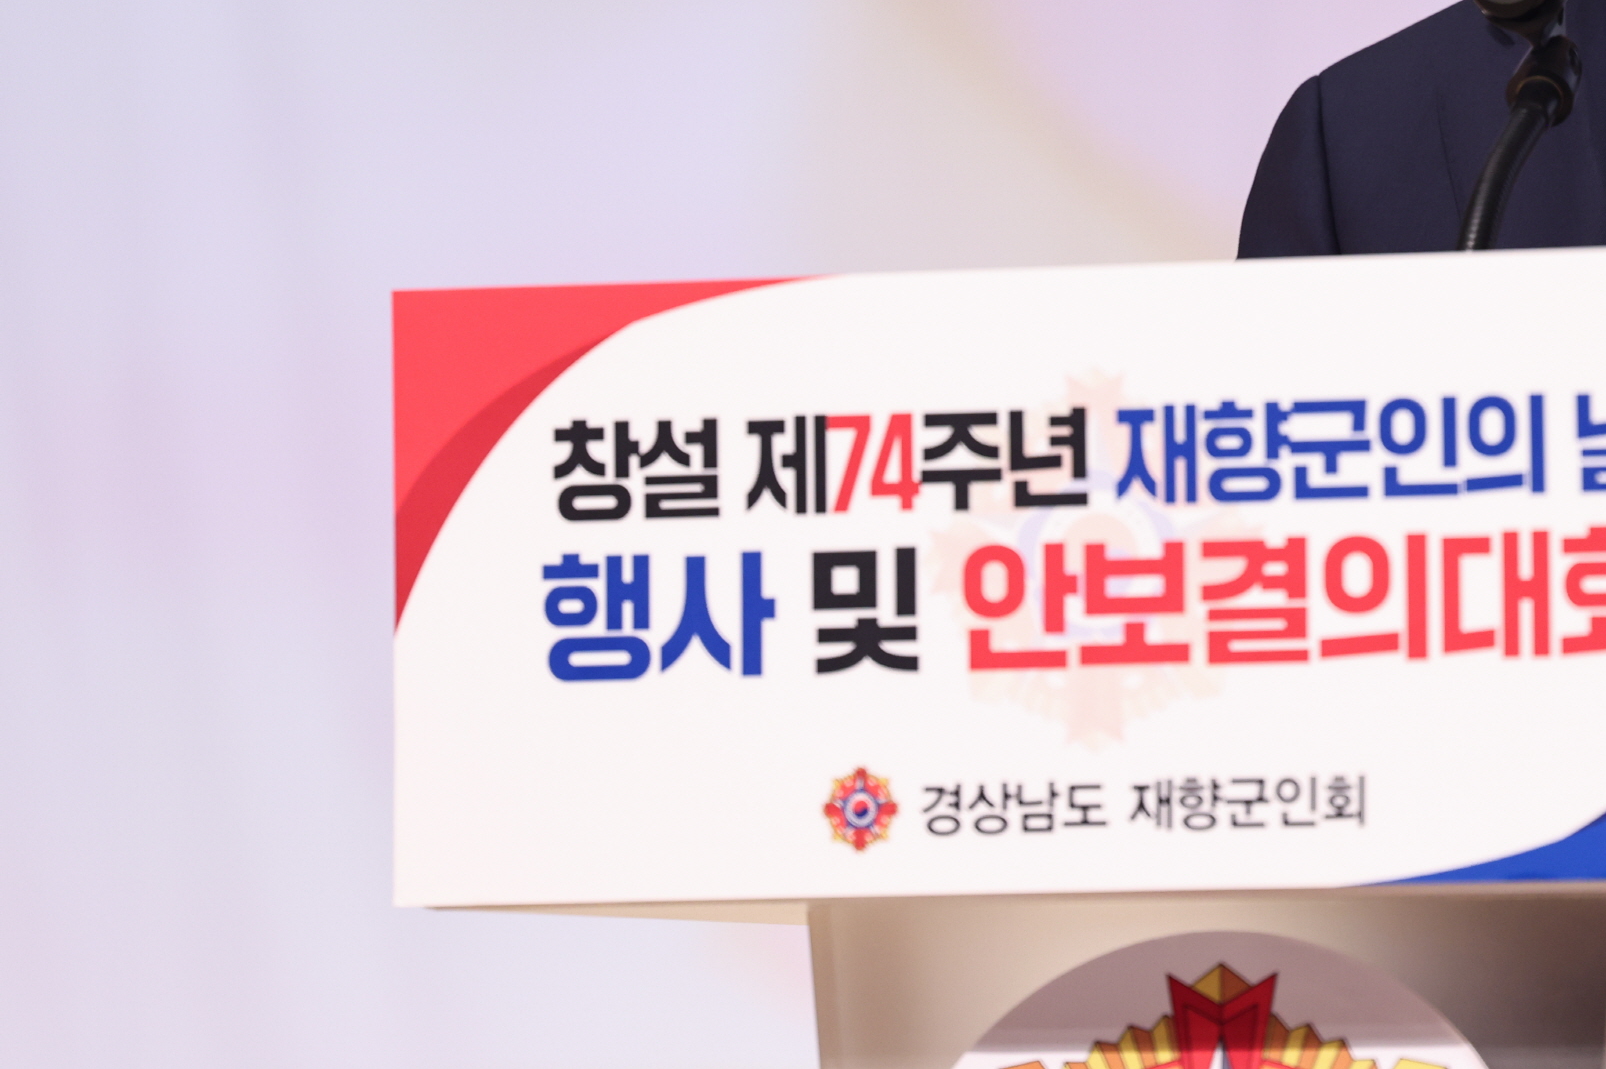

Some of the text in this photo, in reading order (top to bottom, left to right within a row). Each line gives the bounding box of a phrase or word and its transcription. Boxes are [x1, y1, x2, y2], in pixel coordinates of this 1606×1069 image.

[552, 418, 721, 523] 창설
[745, 406, 1089, 515] 제74주년
[1115, 392, 1547, 507] 재향군인의
[541, 550, 777, 682] 행사
[811, 545, 920, 675] 및
[919, 773, 1367, 837] 경상남도 재향군인회
